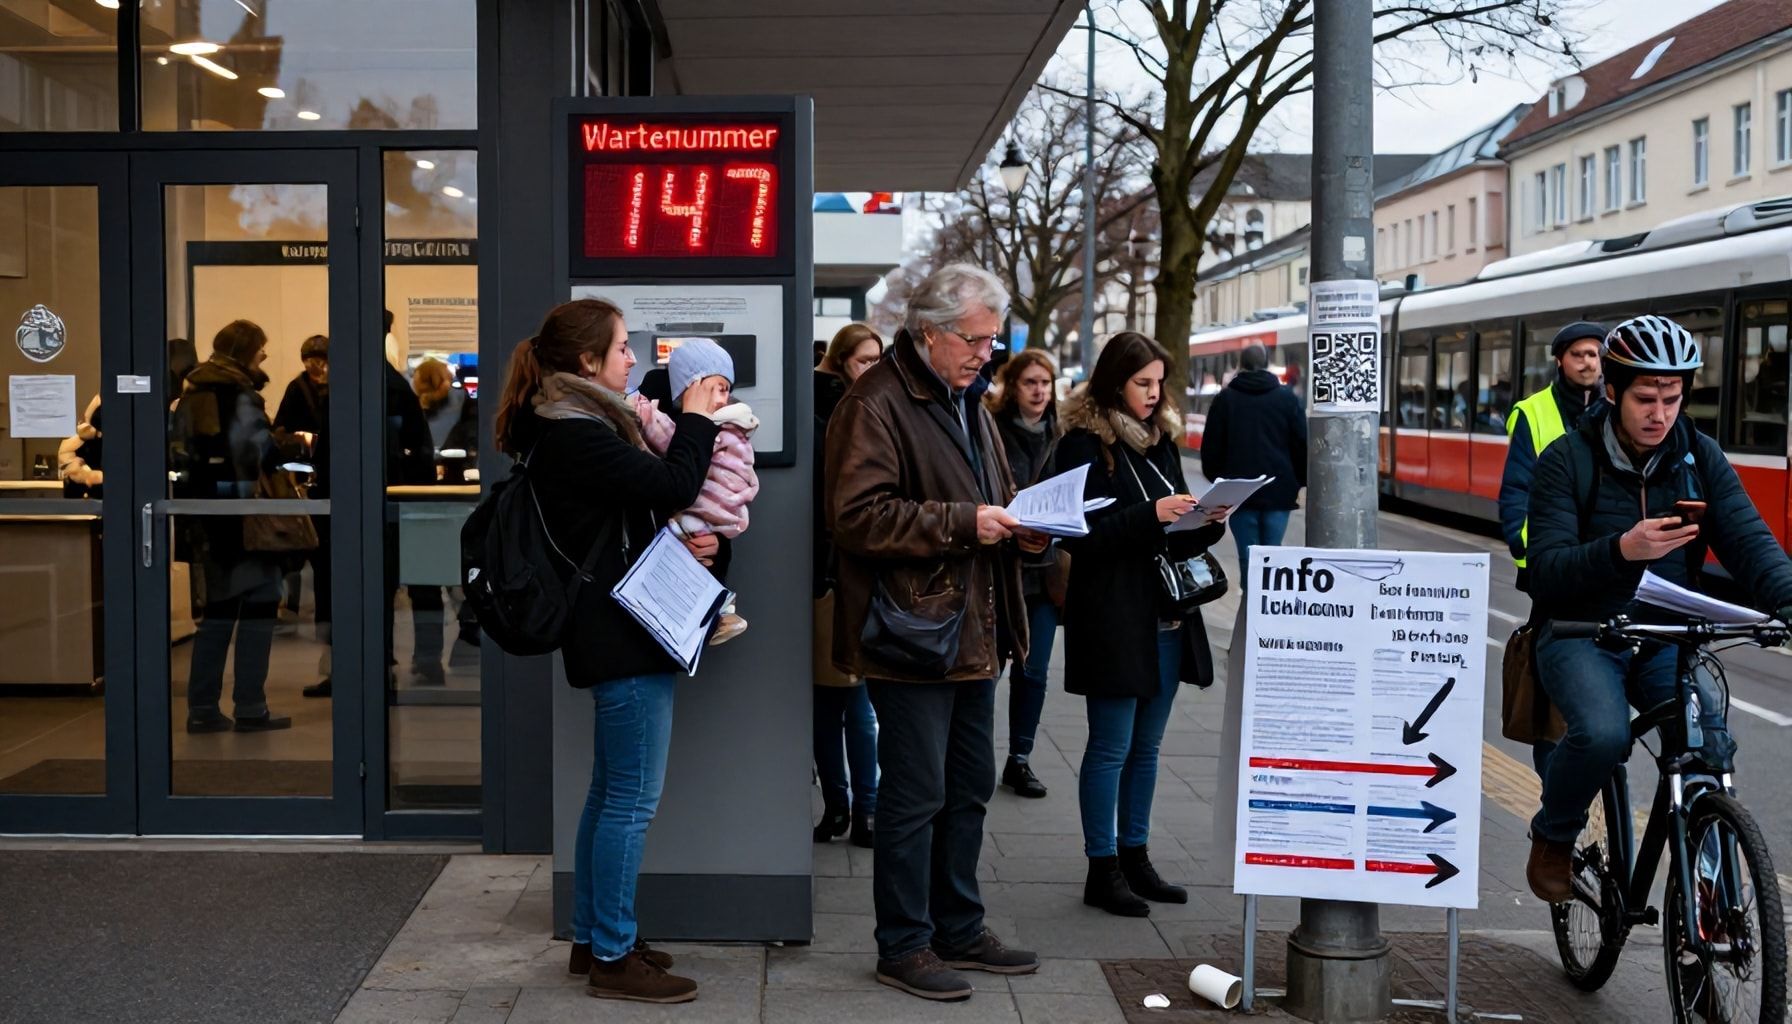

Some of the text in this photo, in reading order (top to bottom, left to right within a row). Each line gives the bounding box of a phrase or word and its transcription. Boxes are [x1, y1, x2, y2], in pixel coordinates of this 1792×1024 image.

[583, 123, 777, 150] Wartenummer
[627, 168, 771, 248] 147
[1261, 556, 1336, 593] info
